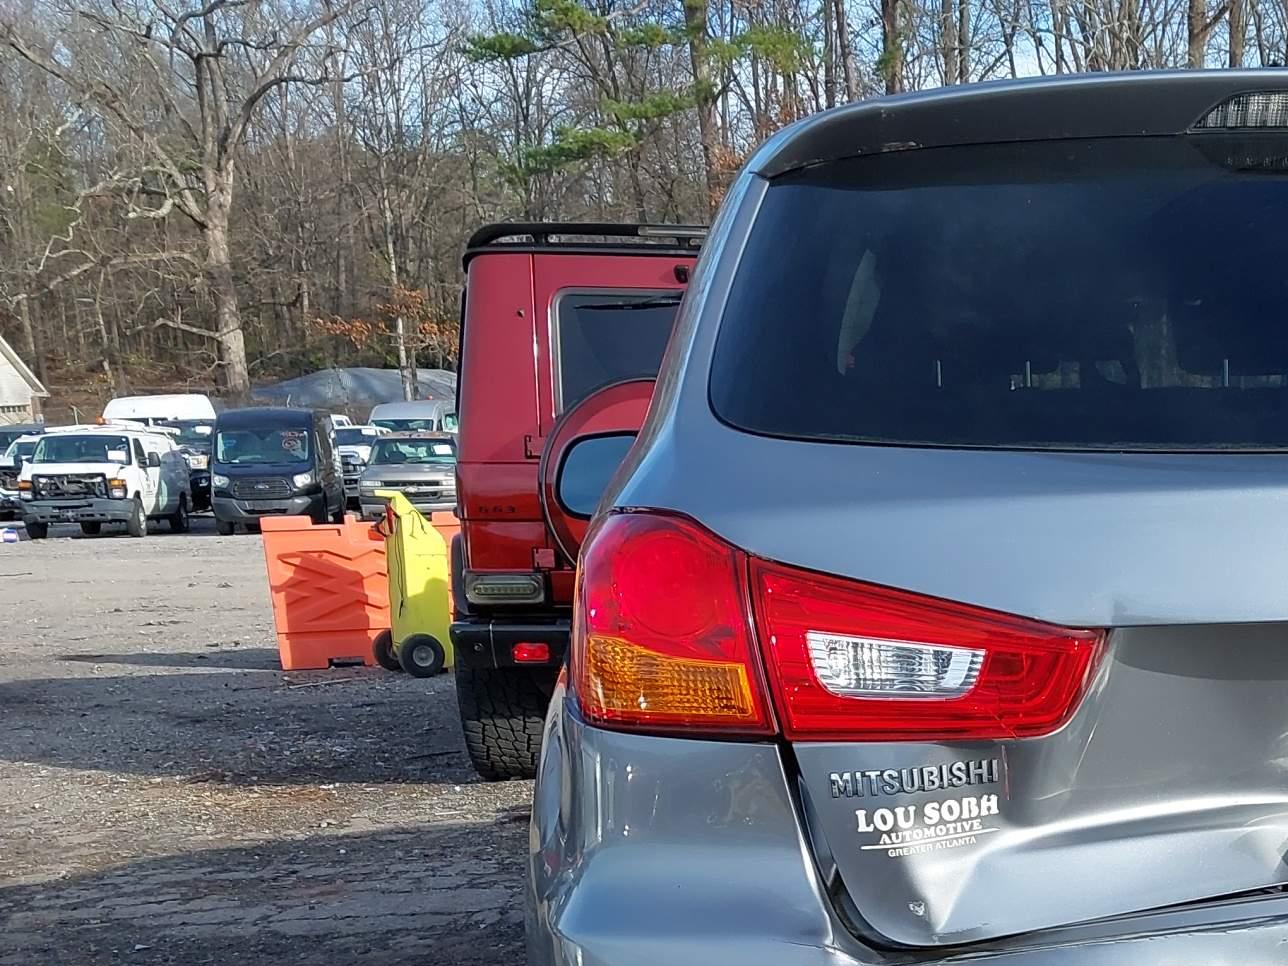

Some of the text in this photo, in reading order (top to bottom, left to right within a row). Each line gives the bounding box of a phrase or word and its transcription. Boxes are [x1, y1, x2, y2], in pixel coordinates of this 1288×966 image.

[829, 758, 999, 798] MITSUBISHI
[855, 805, 916, 833] LOU
[879, 818, 983, 845] AUTOMOTIVE
[887, 836, 977, 858] GREATER ATLANTA
